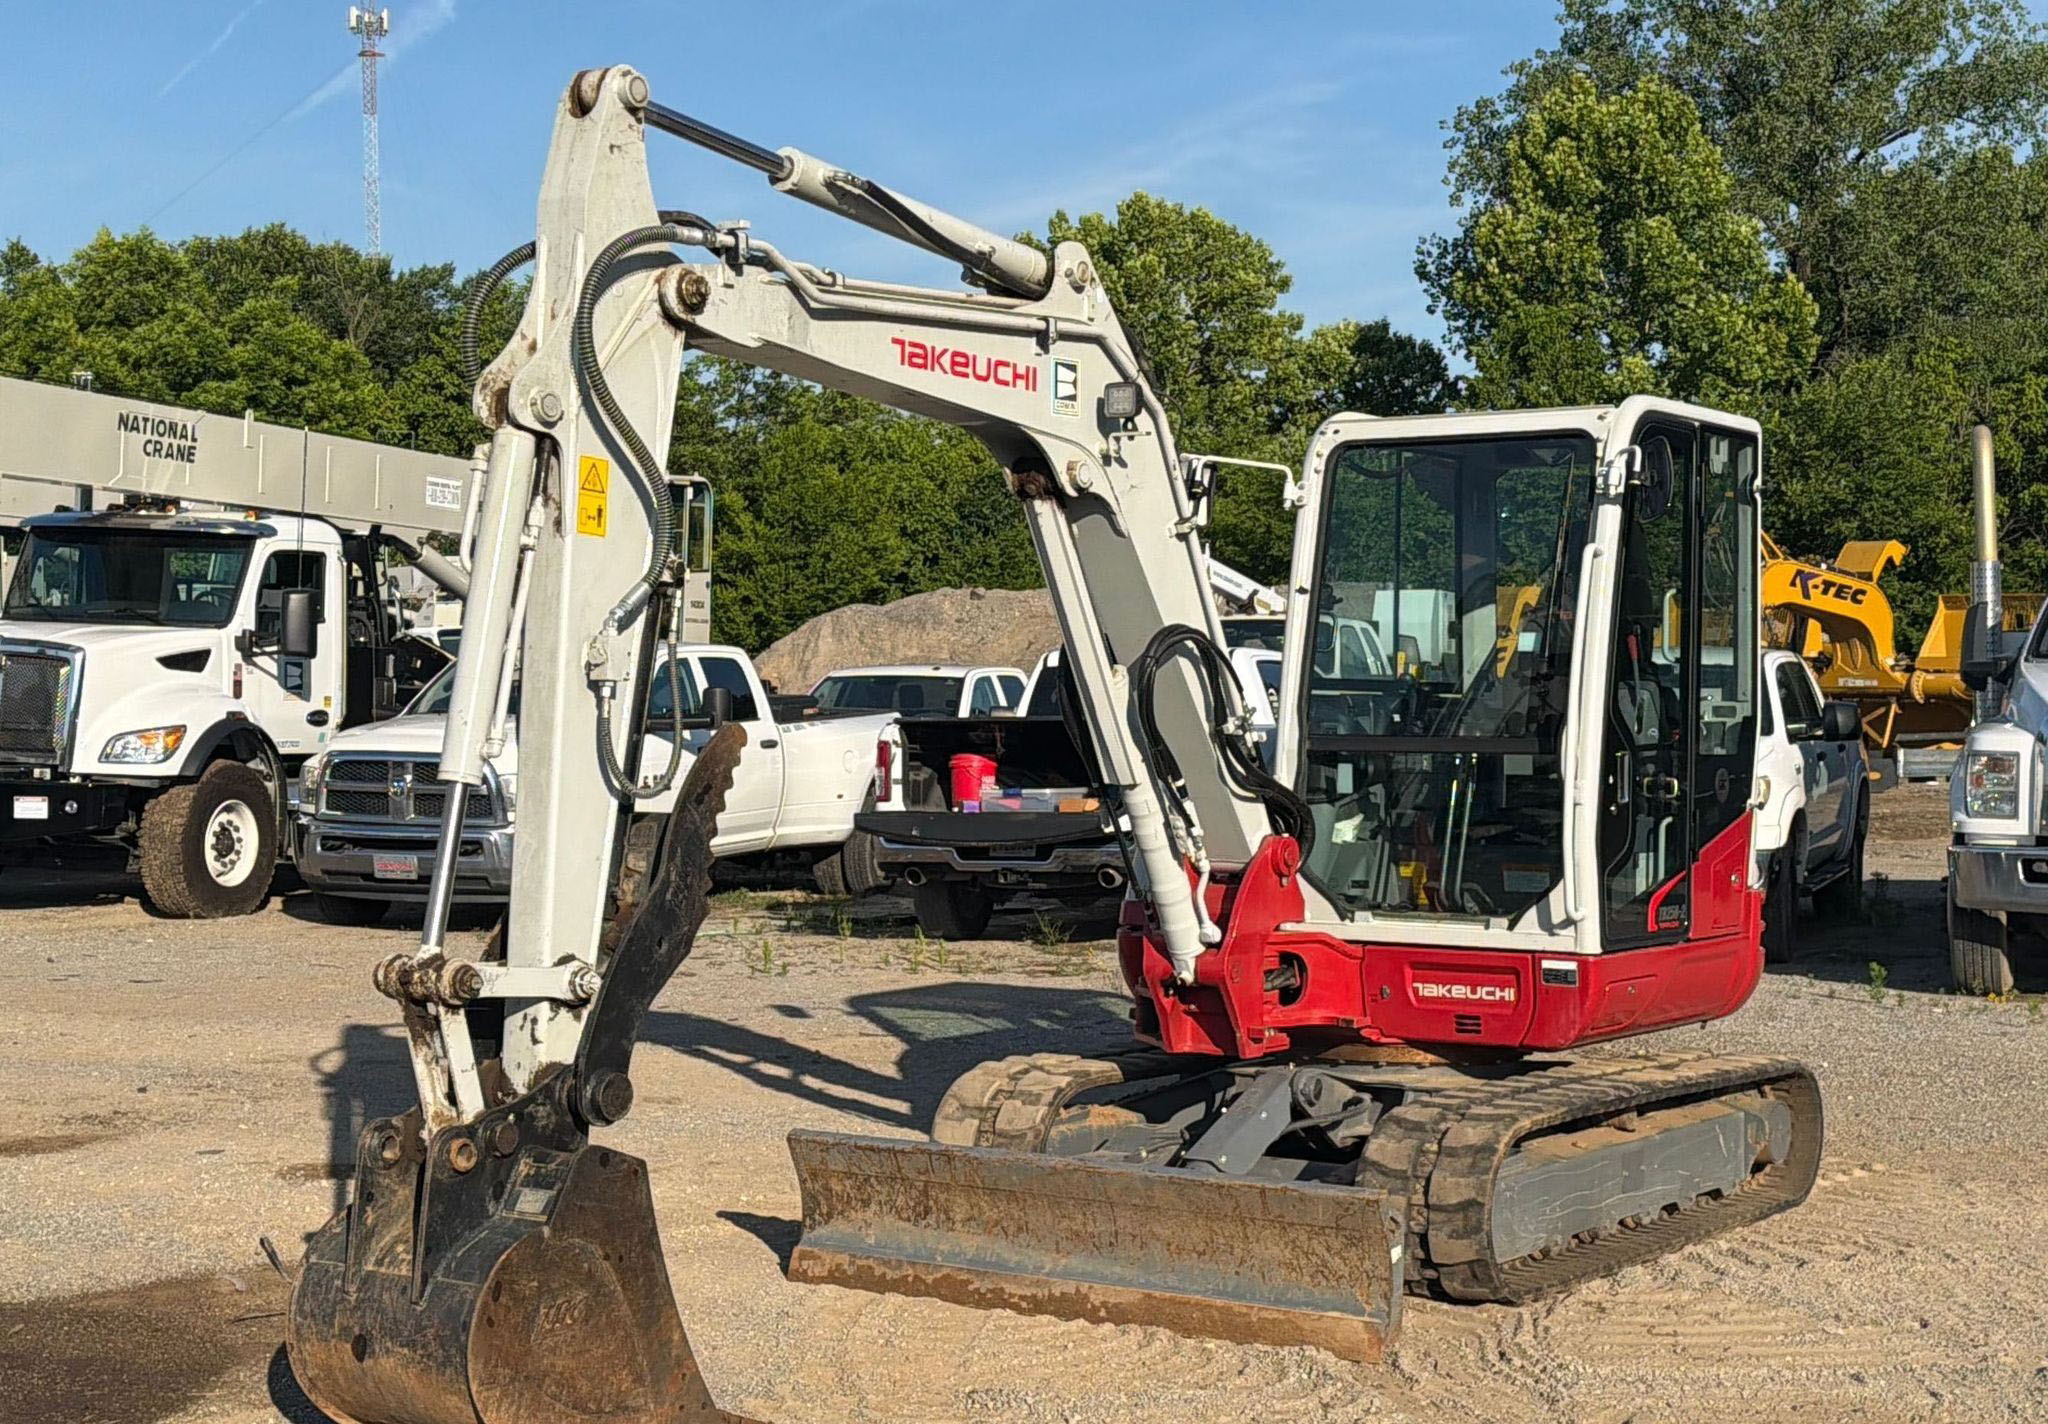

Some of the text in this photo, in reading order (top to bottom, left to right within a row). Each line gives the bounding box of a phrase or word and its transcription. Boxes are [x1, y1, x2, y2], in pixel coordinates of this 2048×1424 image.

[891, 337, 1038, 392] TAKEUCHI
[117, 412, 198, 443] NATIONAL
[143, 439, 197, 463] CRANE
[1789, 568, 1868, 605] K-TEC
[1413, 982, 1516, 1001] TAKEUCHI
